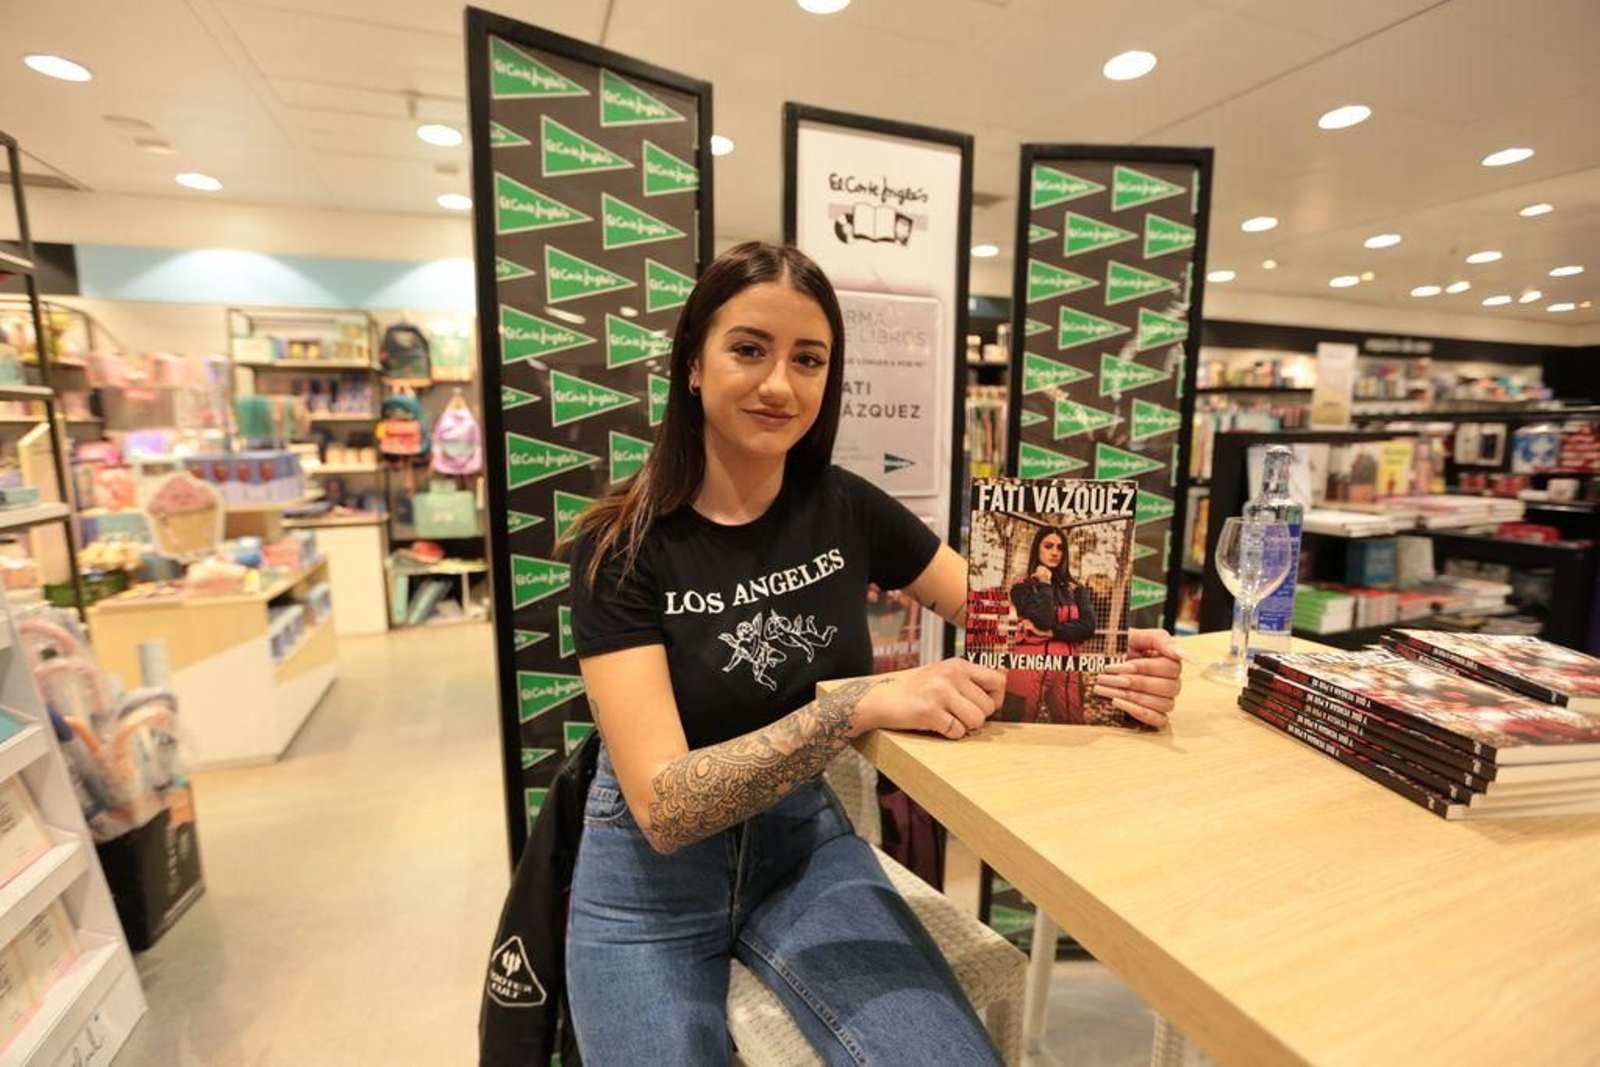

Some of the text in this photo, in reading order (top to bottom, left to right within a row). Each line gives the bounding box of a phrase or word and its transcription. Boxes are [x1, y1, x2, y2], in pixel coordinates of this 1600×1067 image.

[830, 173, 928, 205] El Corte Inglés
[846, 309, 886, 326] RMA
[860, 329, 926, 347] LIBROS
[842, 381, 871, 396] ATI
[842, 400, 920, 419] ÁZQUEZ
[979, 480, 1135, 518] FATI VÁZQUEZ
[664, 548, 845, 614] LOS ANGELES
[968, 652, 976, 664] Y
[980, 652, 1006, 670] QUE
[1010, 654, 1062, 671] VENGAN
[1066, 655, 1074, 671] A
[1079, 656, 1104, 672] POR
